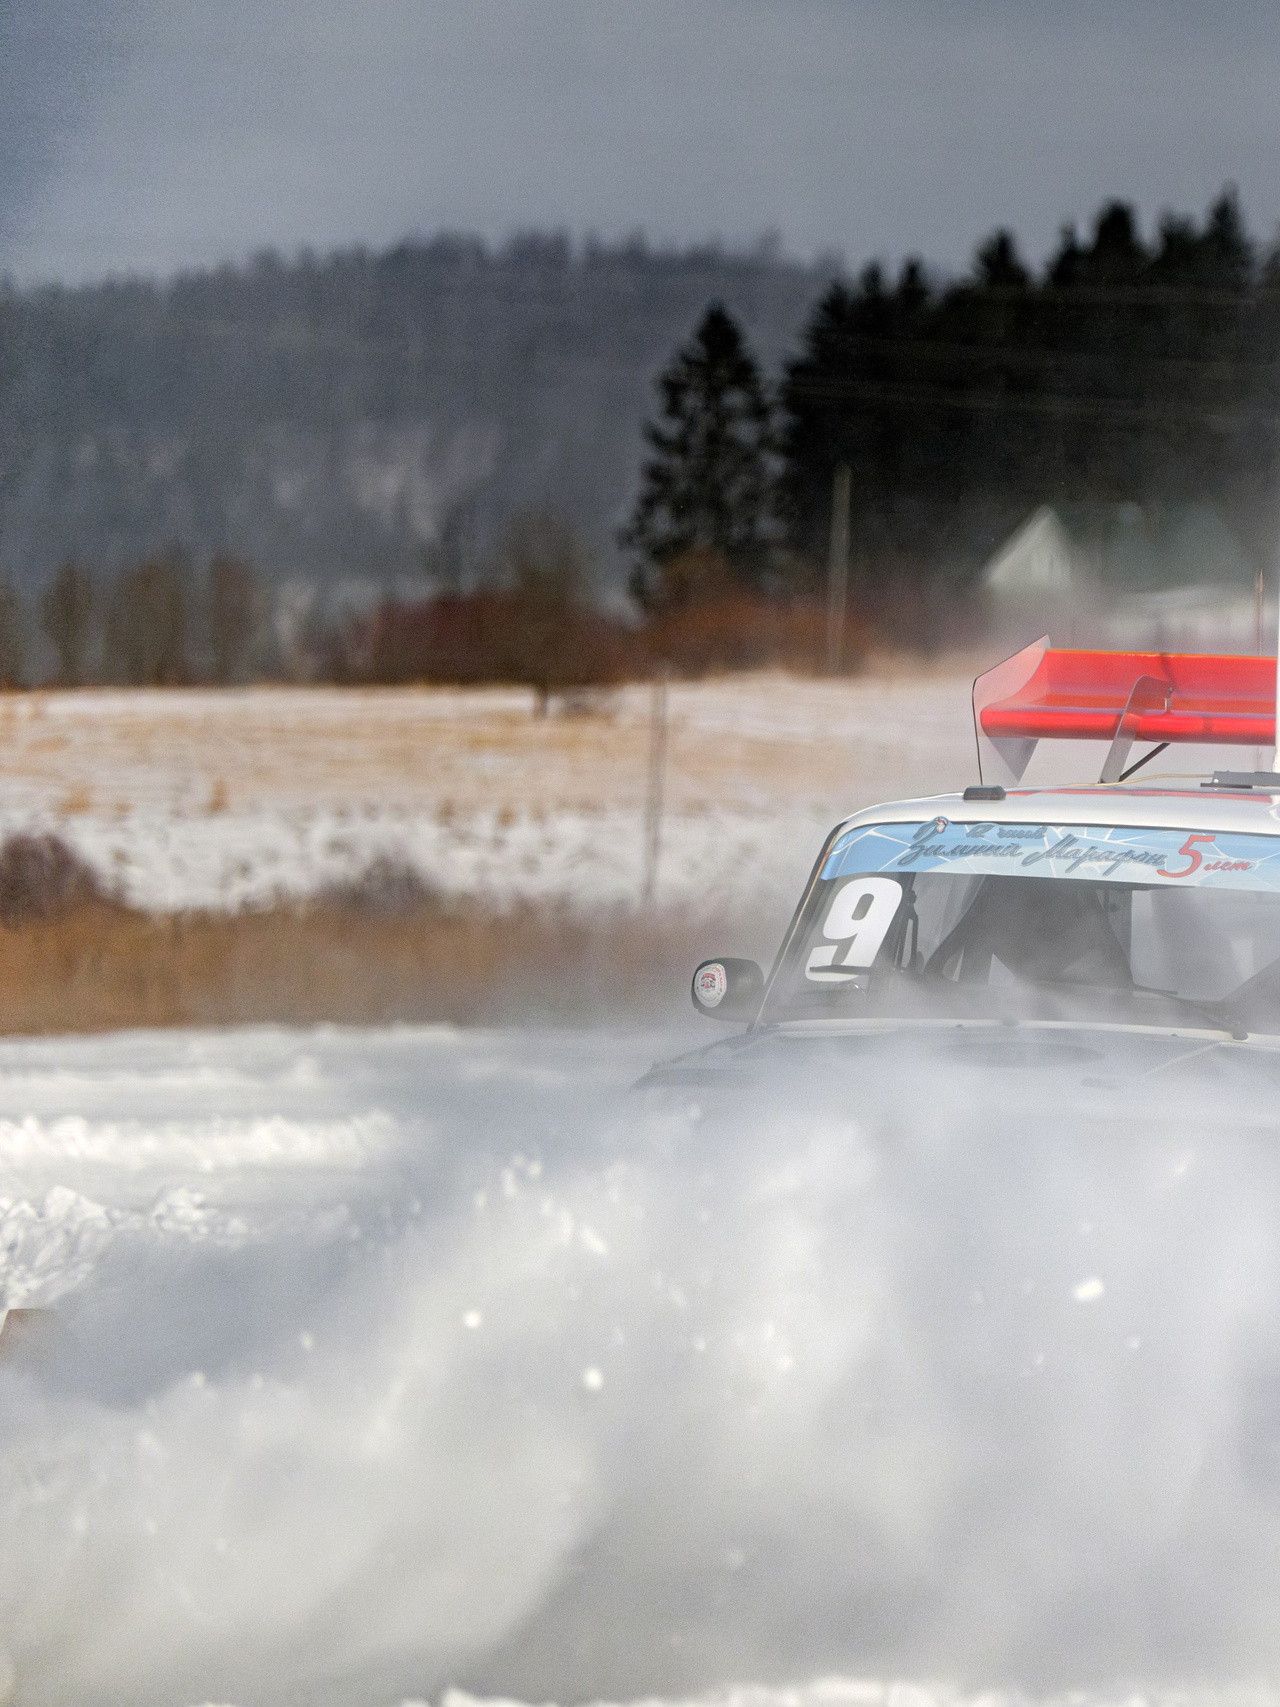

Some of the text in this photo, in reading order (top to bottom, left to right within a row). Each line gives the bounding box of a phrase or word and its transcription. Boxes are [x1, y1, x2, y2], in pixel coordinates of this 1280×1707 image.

[1021, 833, 1168, 877] Марафон
[1157, 834, 1217, 878] 5
[1203, 860, 1253, 872] лет
[805, 877, 903, 982] 9
